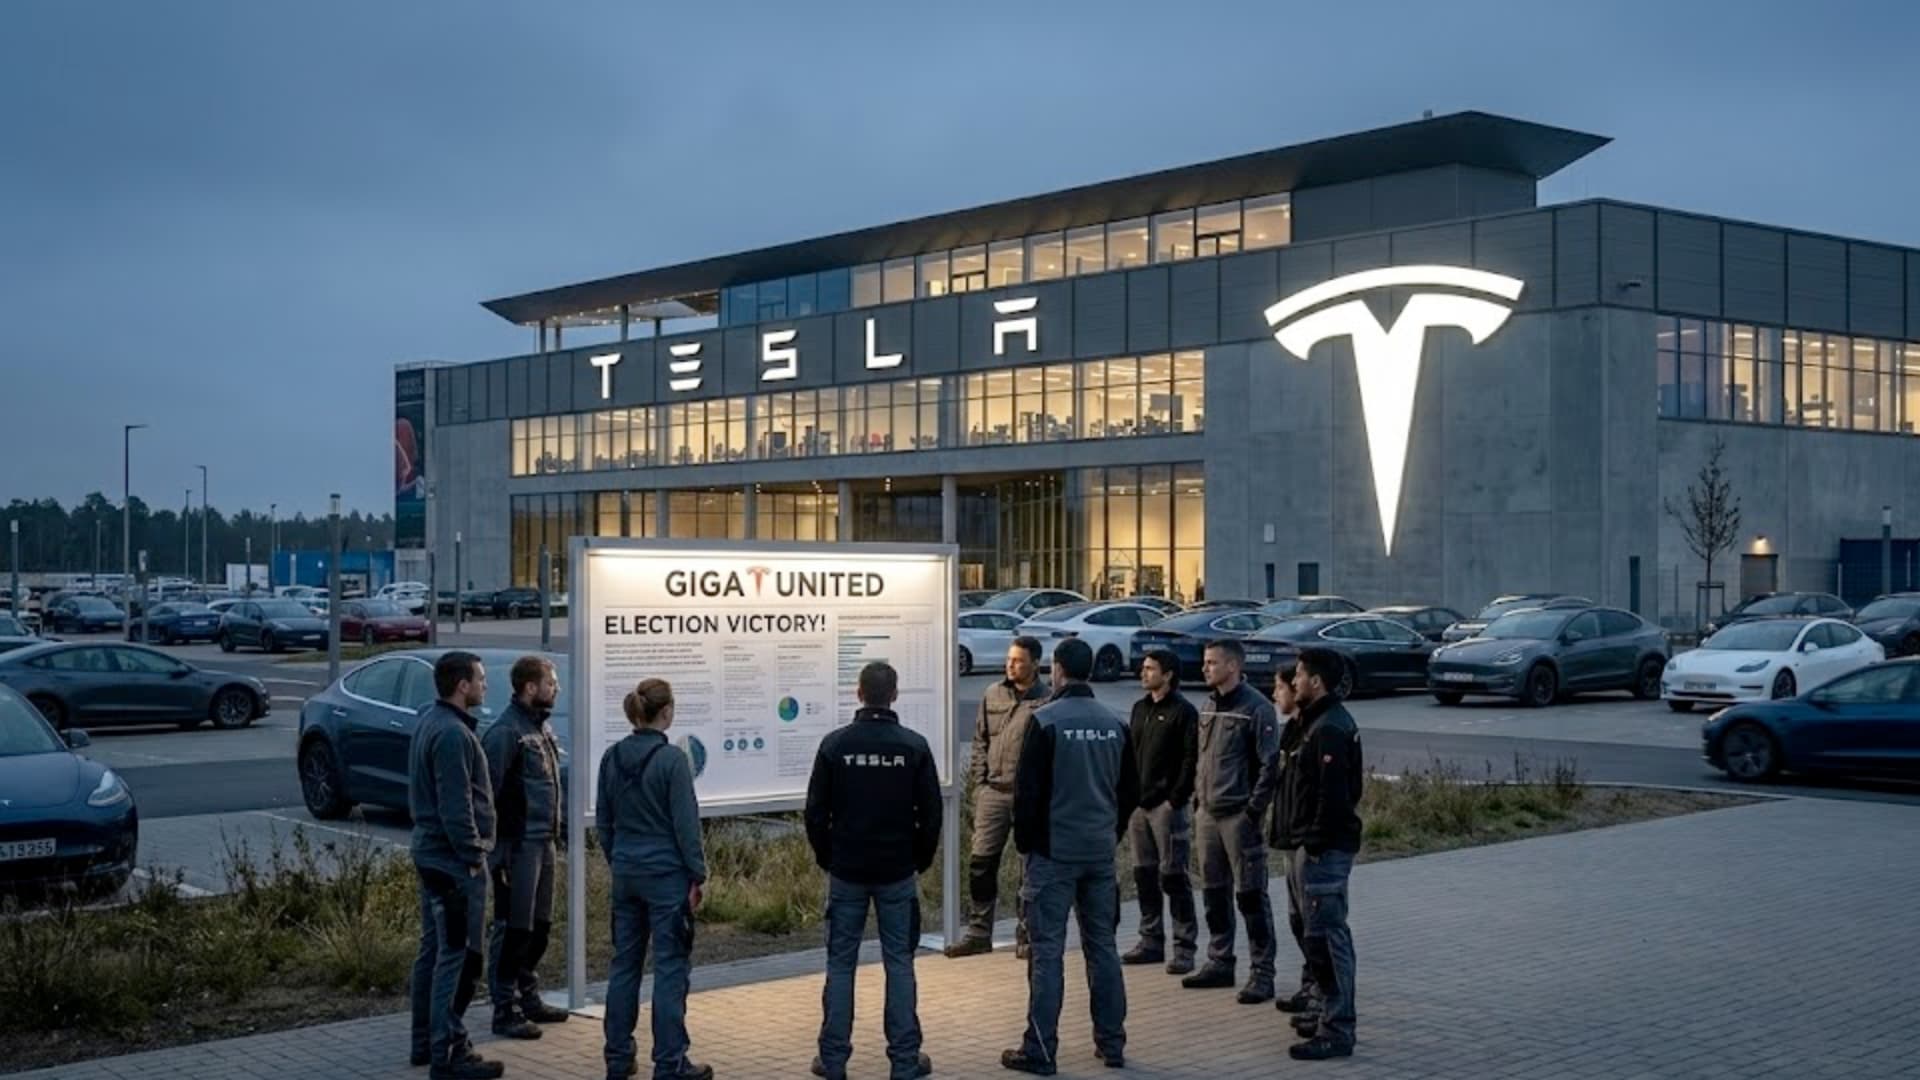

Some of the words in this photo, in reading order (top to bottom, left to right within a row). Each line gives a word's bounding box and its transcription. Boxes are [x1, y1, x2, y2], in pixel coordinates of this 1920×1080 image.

[590, 297, 1038, 399] TESLA
[665, 570, 744, 598] GIGA
[776, 571, 884, 598] UNITED
[605, 614, 719, 635] ELECTION
[727, 613, 826, 634] VICTORY!
[1064, 728, 1117, 740] TESLA
[843, 753, 905, 767] TESLA
